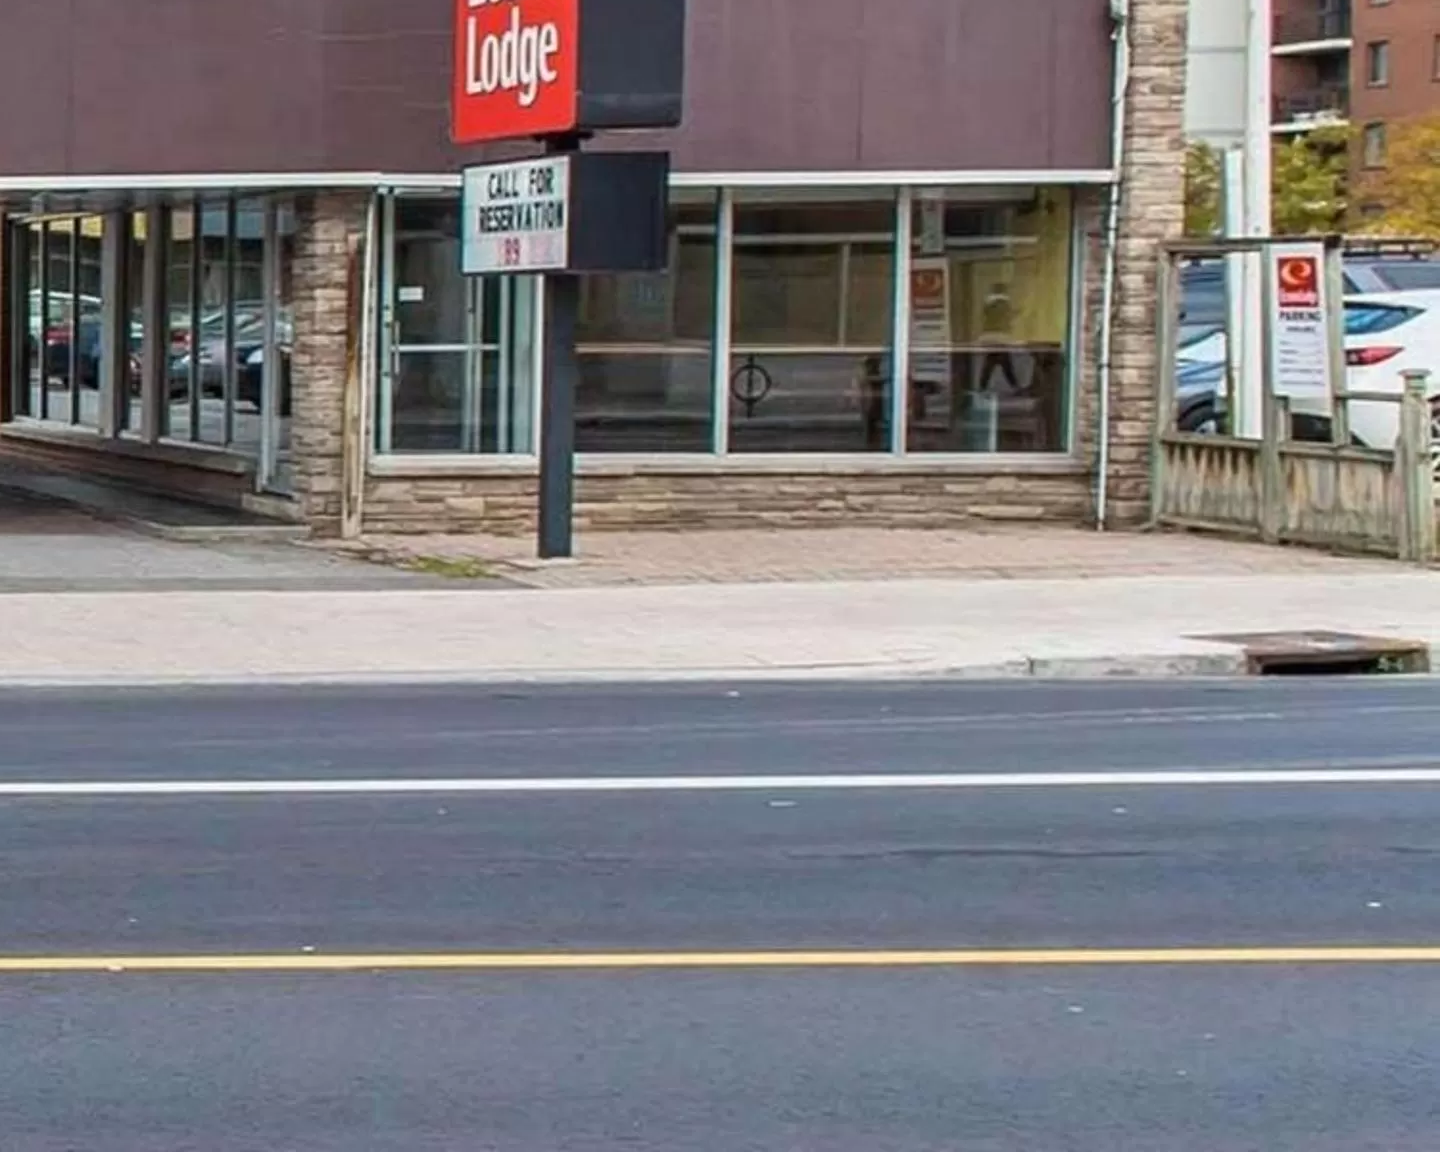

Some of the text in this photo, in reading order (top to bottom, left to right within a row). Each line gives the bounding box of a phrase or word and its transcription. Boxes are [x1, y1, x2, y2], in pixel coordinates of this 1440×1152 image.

[466, 6, 558, 106] Lodge
[487, 166, 555, 200] CALL FOR
[479, 201, 564, 234] RESERVATION
[1279, 311, 1322, 321] PARKING
